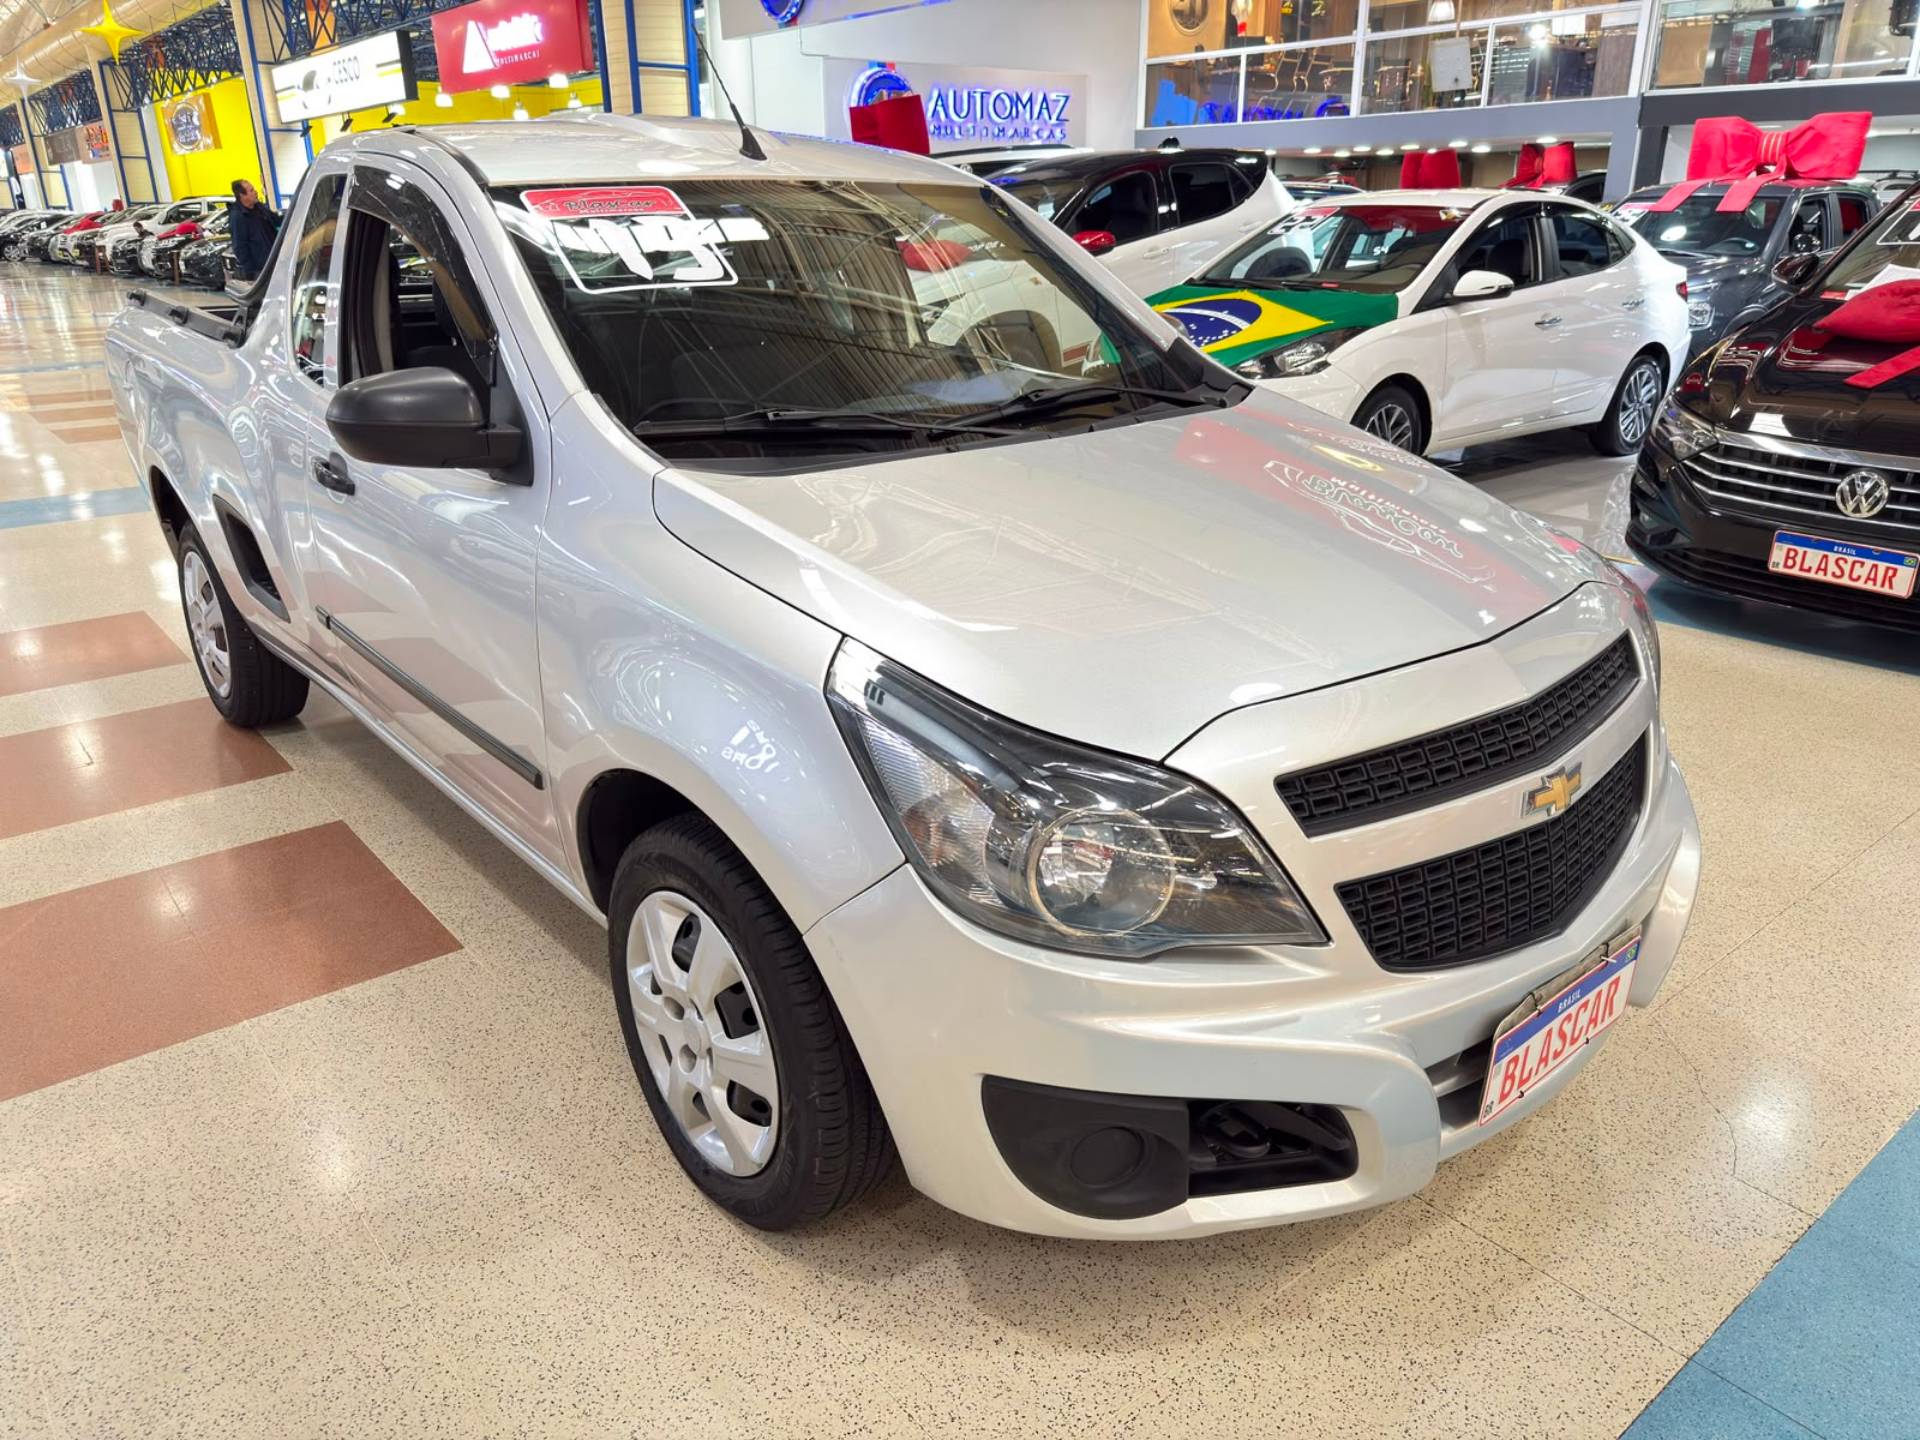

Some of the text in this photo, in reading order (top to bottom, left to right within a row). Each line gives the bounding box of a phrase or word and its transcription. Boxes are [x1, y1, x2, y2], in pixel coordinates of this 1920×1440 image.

[930, 89, 1070, 123] AUTOMAZ
[932, 125, 1067, 139] MULTIMARCAS
[1833, 545, 1857, 555] BRASIL
[1783, 548, 1898, 590] BLASCAR
[1558, 989, 1582, 1013] BRASIL
[1498, 975, 1621, 1104] BLASCAR
